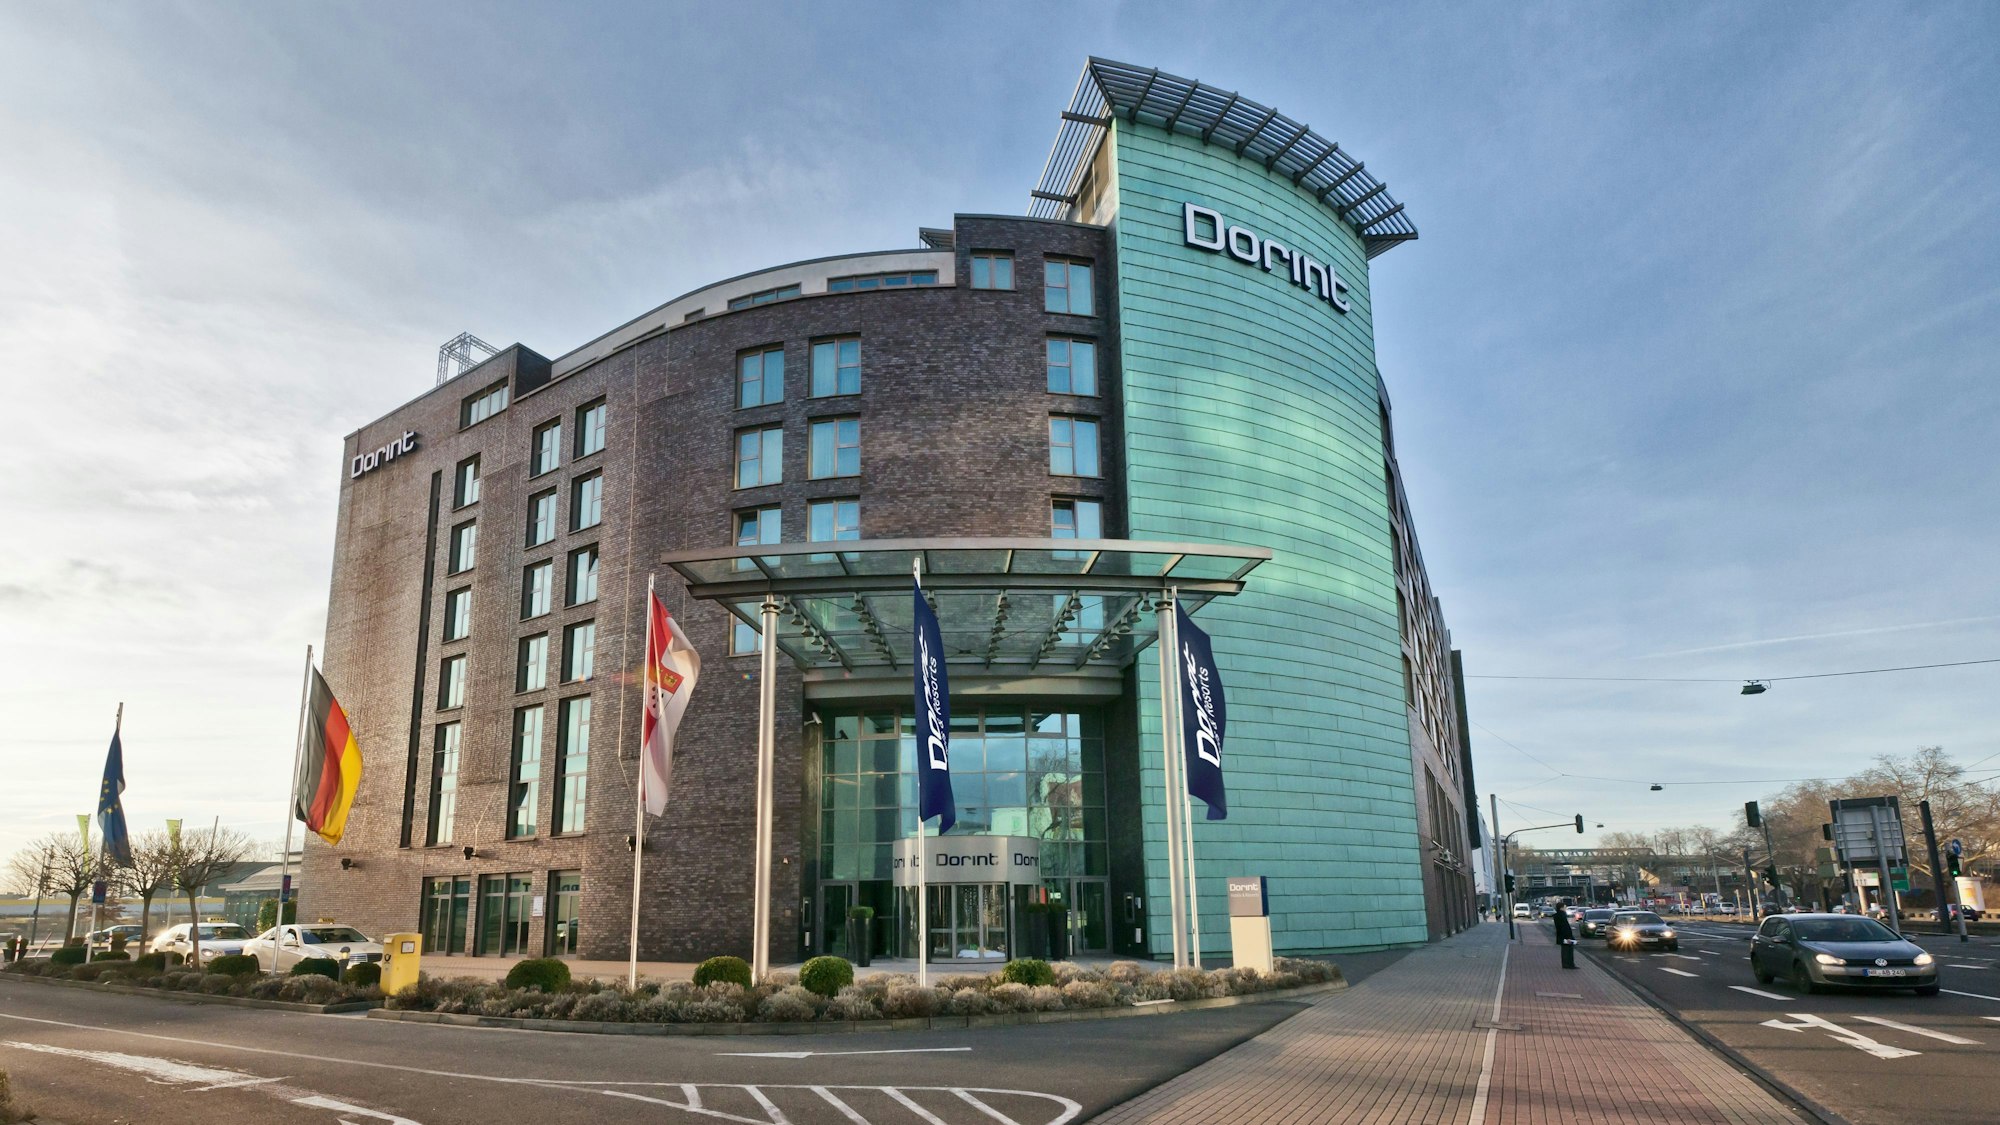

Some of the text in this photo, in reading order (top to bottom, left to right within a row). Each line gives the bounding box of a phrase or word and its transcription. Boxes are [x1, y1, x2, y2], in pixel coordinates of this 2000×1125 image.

[1183, 202, 1351, 315] Dorint
[351, 430, 416, 479] Dorint
[928, 656, 942, 716] Resorts
[1198, 666, 1215, 718] Resorts
[936, 853, 999, 866] Dorint
[1229, 883, 1258, 891] Dorint
